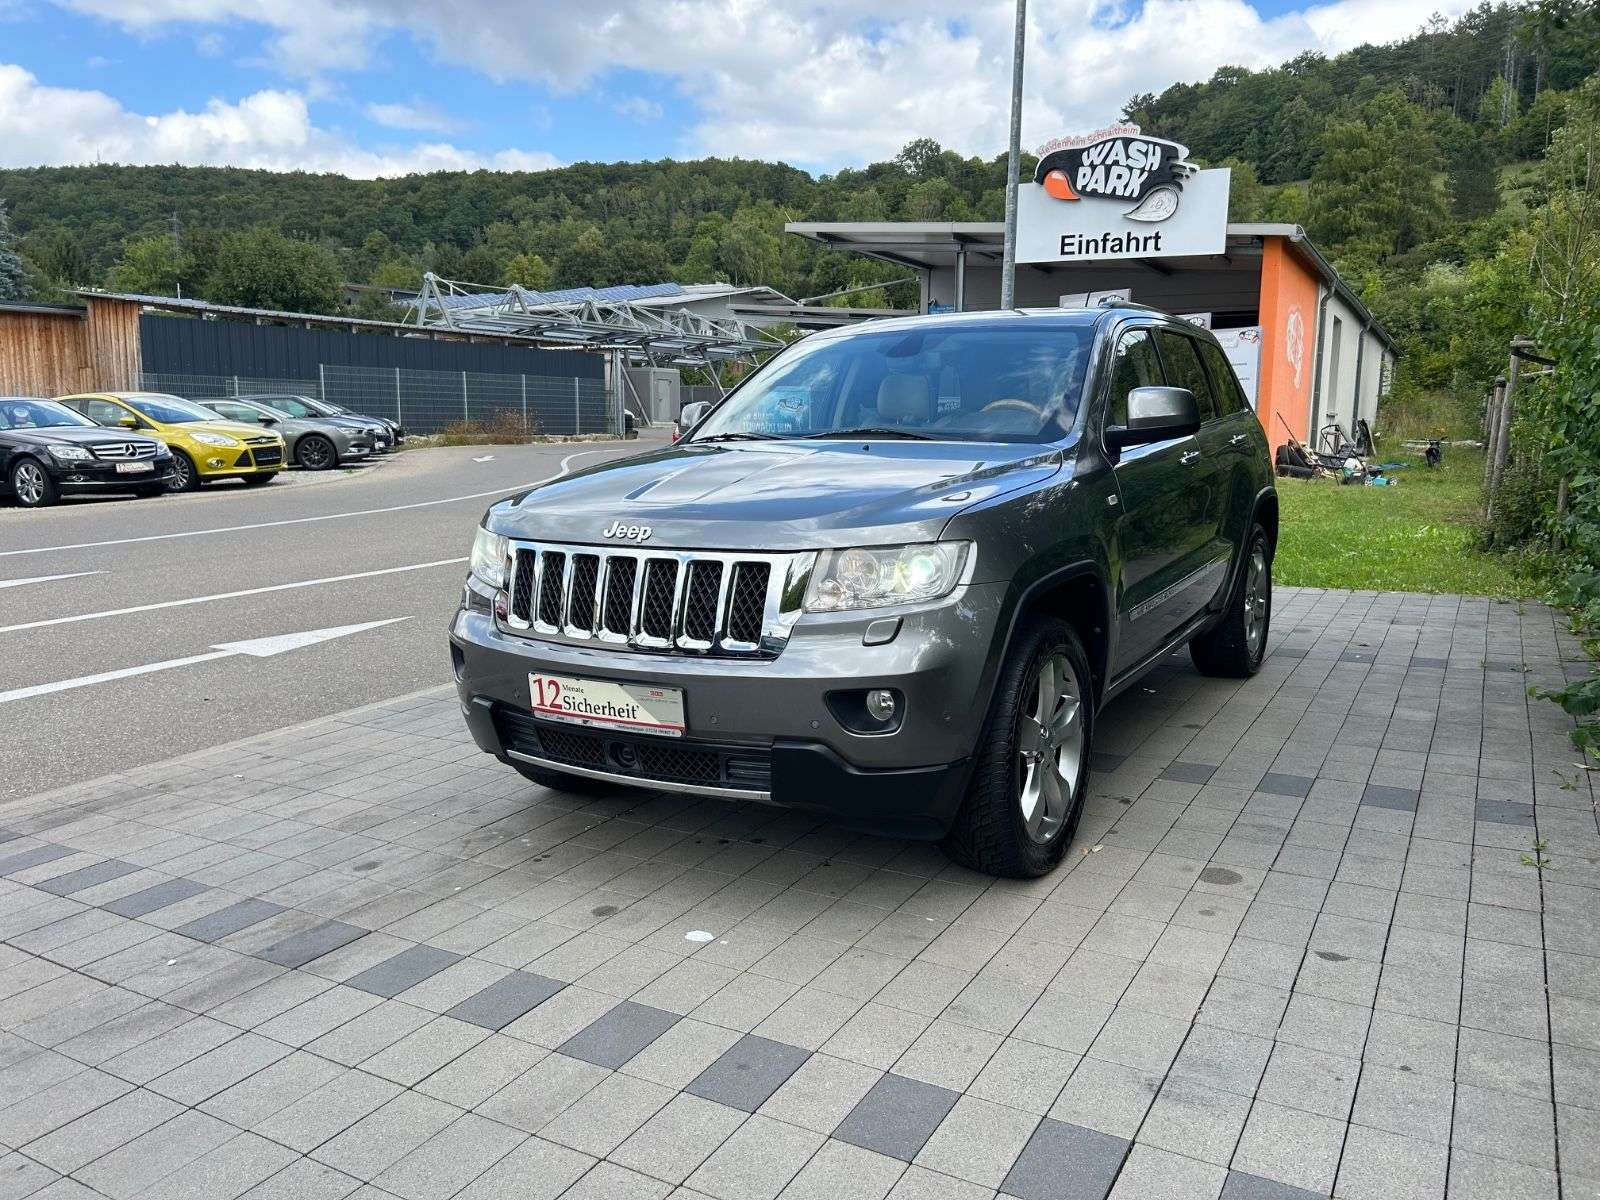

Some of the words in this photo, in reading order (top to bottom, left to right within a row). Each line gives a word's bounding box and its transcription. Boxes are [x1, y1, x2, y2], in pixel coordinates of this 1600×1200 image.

[1082, 139, 1162, 171] WASH
[1076, 165, 1149, 198] PARK
[1060, 230, 1162, 256] Einfahrt
[603, 520, 652, 543] Jeep
[533, 677, 562, 710] 12
[562, 683, 585, 694] Monate
